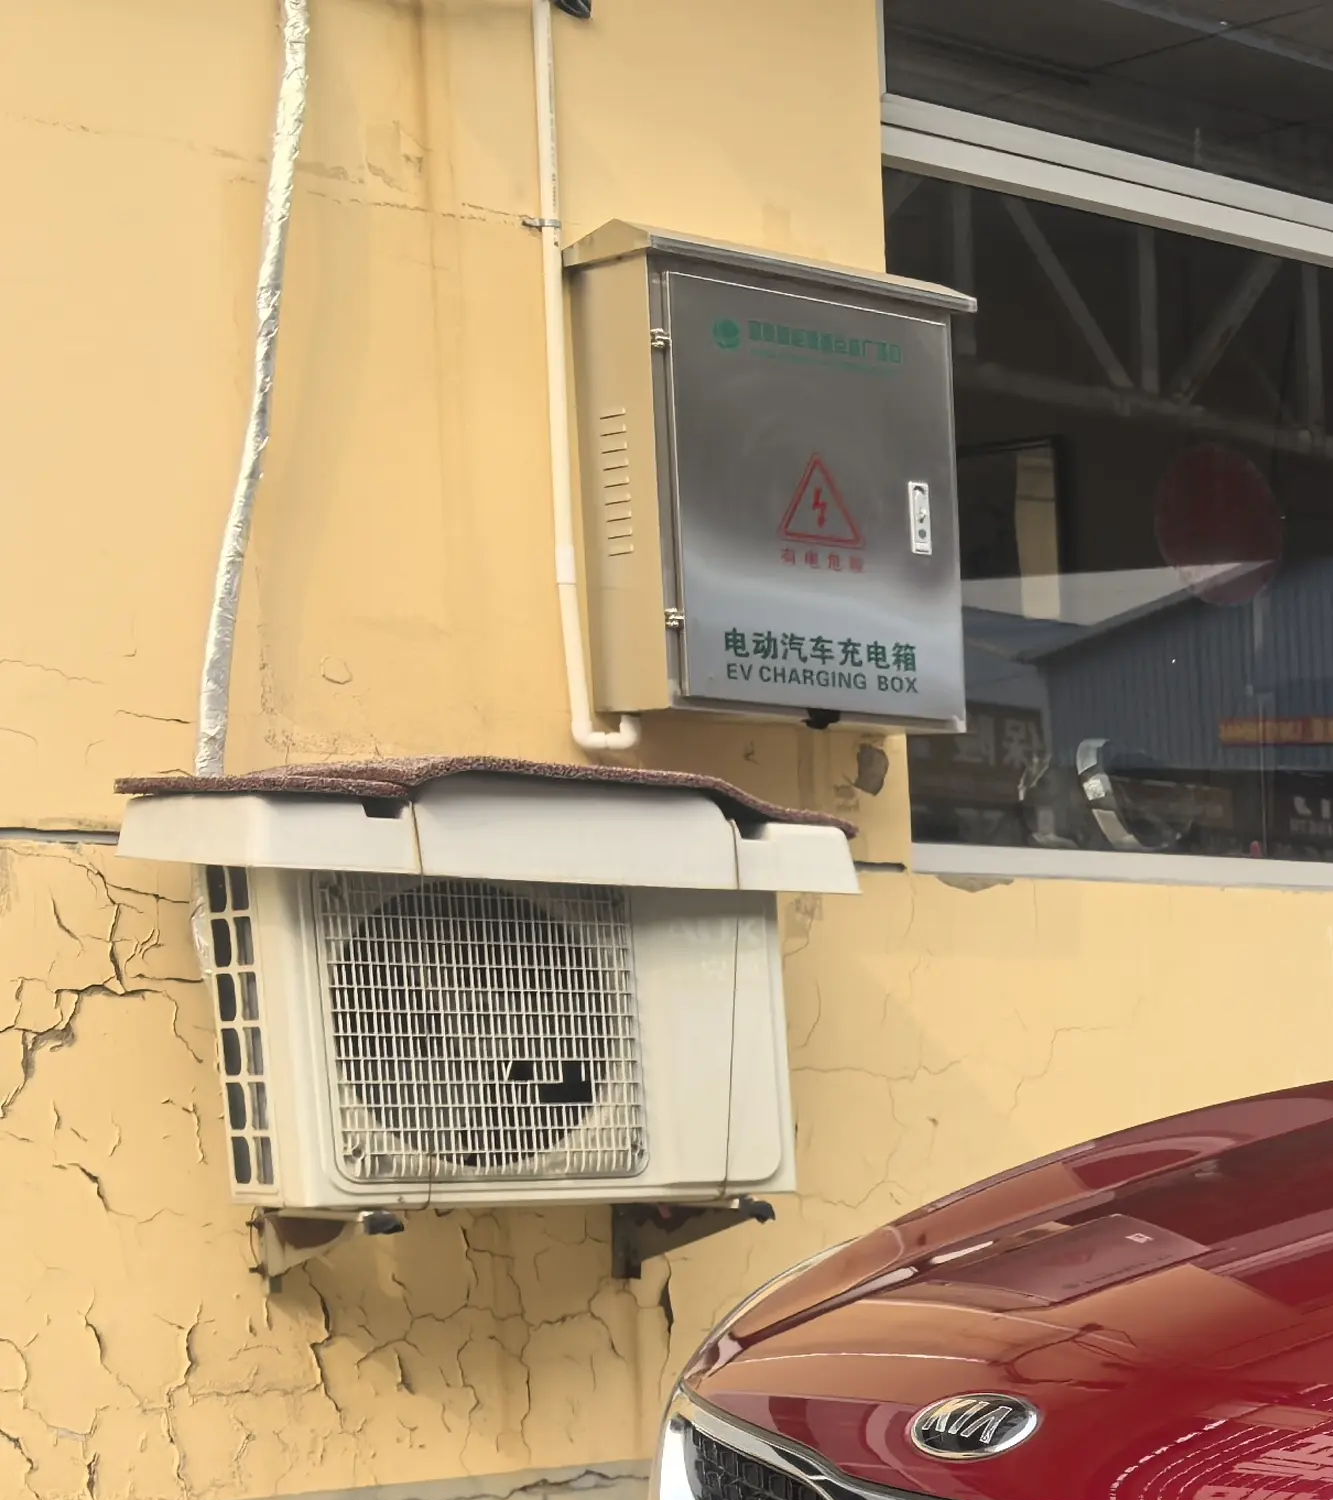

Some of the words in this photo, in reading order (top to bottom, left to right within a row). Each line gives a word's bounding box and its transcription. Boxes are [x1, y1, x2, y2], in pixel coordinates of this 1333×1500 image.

[724, 626, 917, 672] 电动汽车充电箱
[727, 663, 753, 681] EV
[759, 666, 867, 690] CHARGING
[877, 675, 919, 694] BOX
[921, 1398, 1013, 1444] KIA
